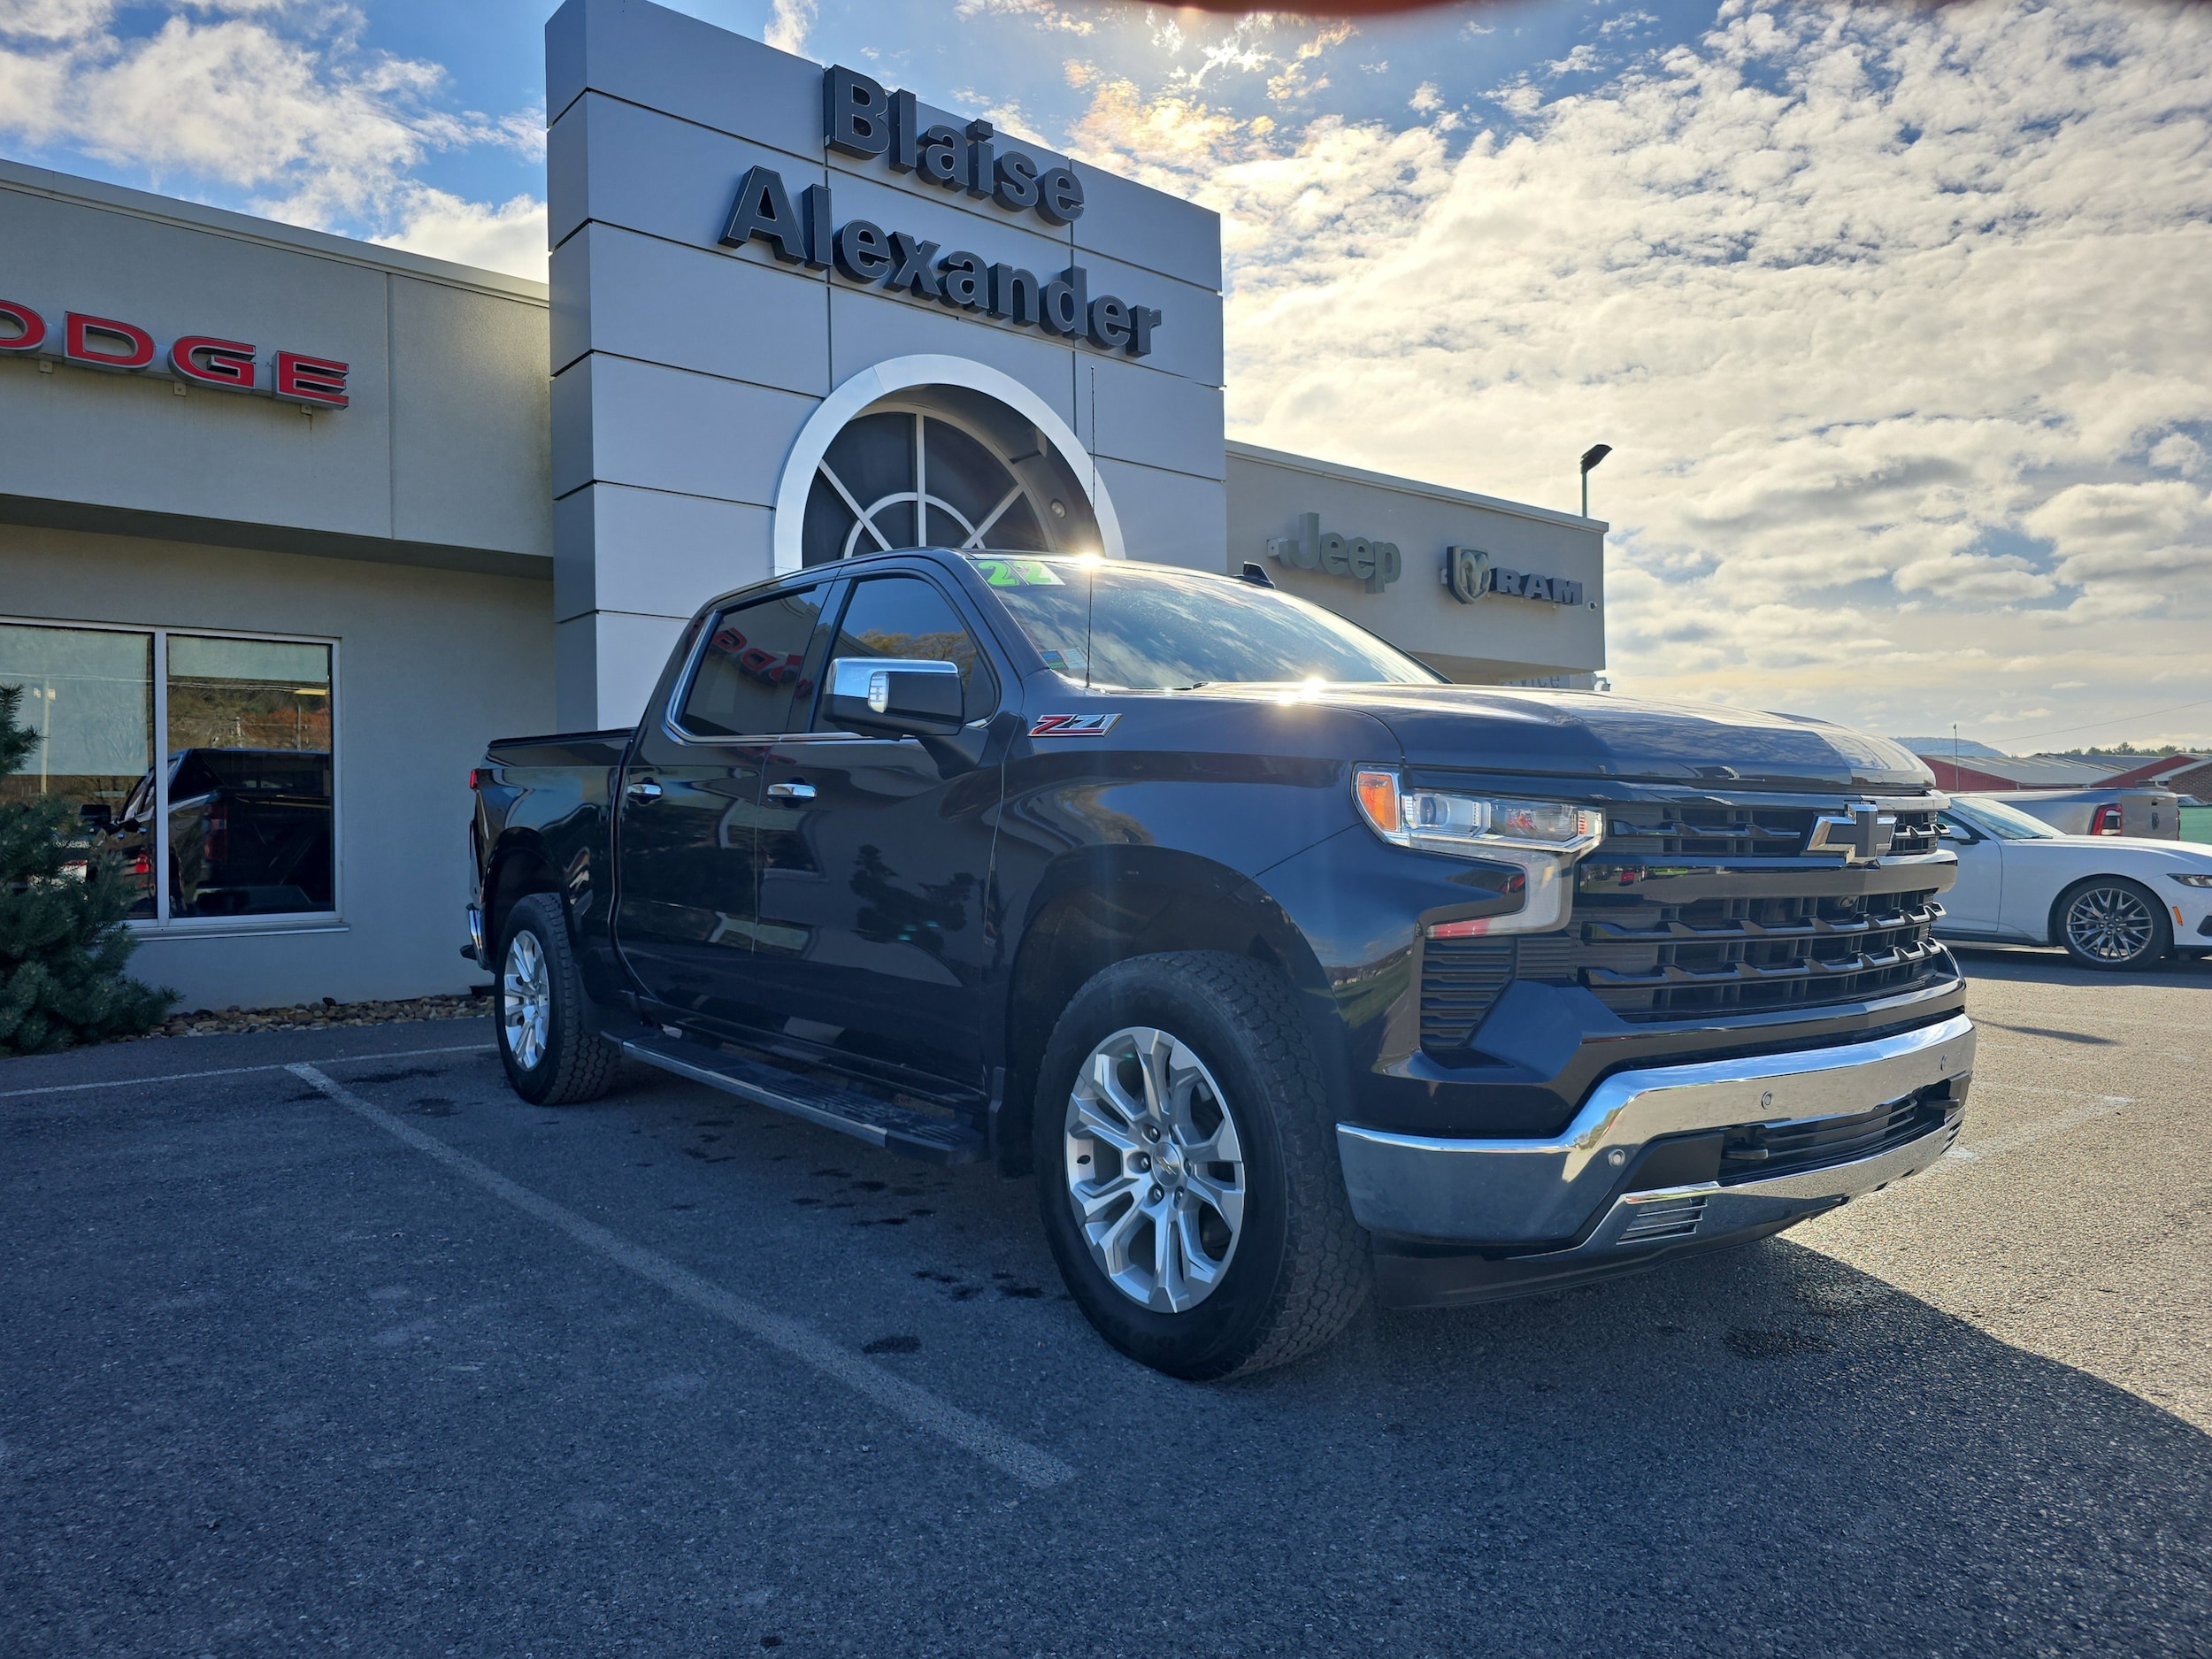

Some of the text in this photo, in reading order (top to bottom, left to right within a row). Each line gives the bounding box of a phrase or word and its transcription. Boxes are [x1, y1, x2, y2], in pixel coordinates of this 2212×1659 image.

[823, 64, 1085, 227] Blaise
[718, 165, 1162, 357] Alexander
[1279, 511, 1402, 595] Jeep
[1490, 566, 1583, 605] RAM
[1027, 713, 1123, 737] Z71
